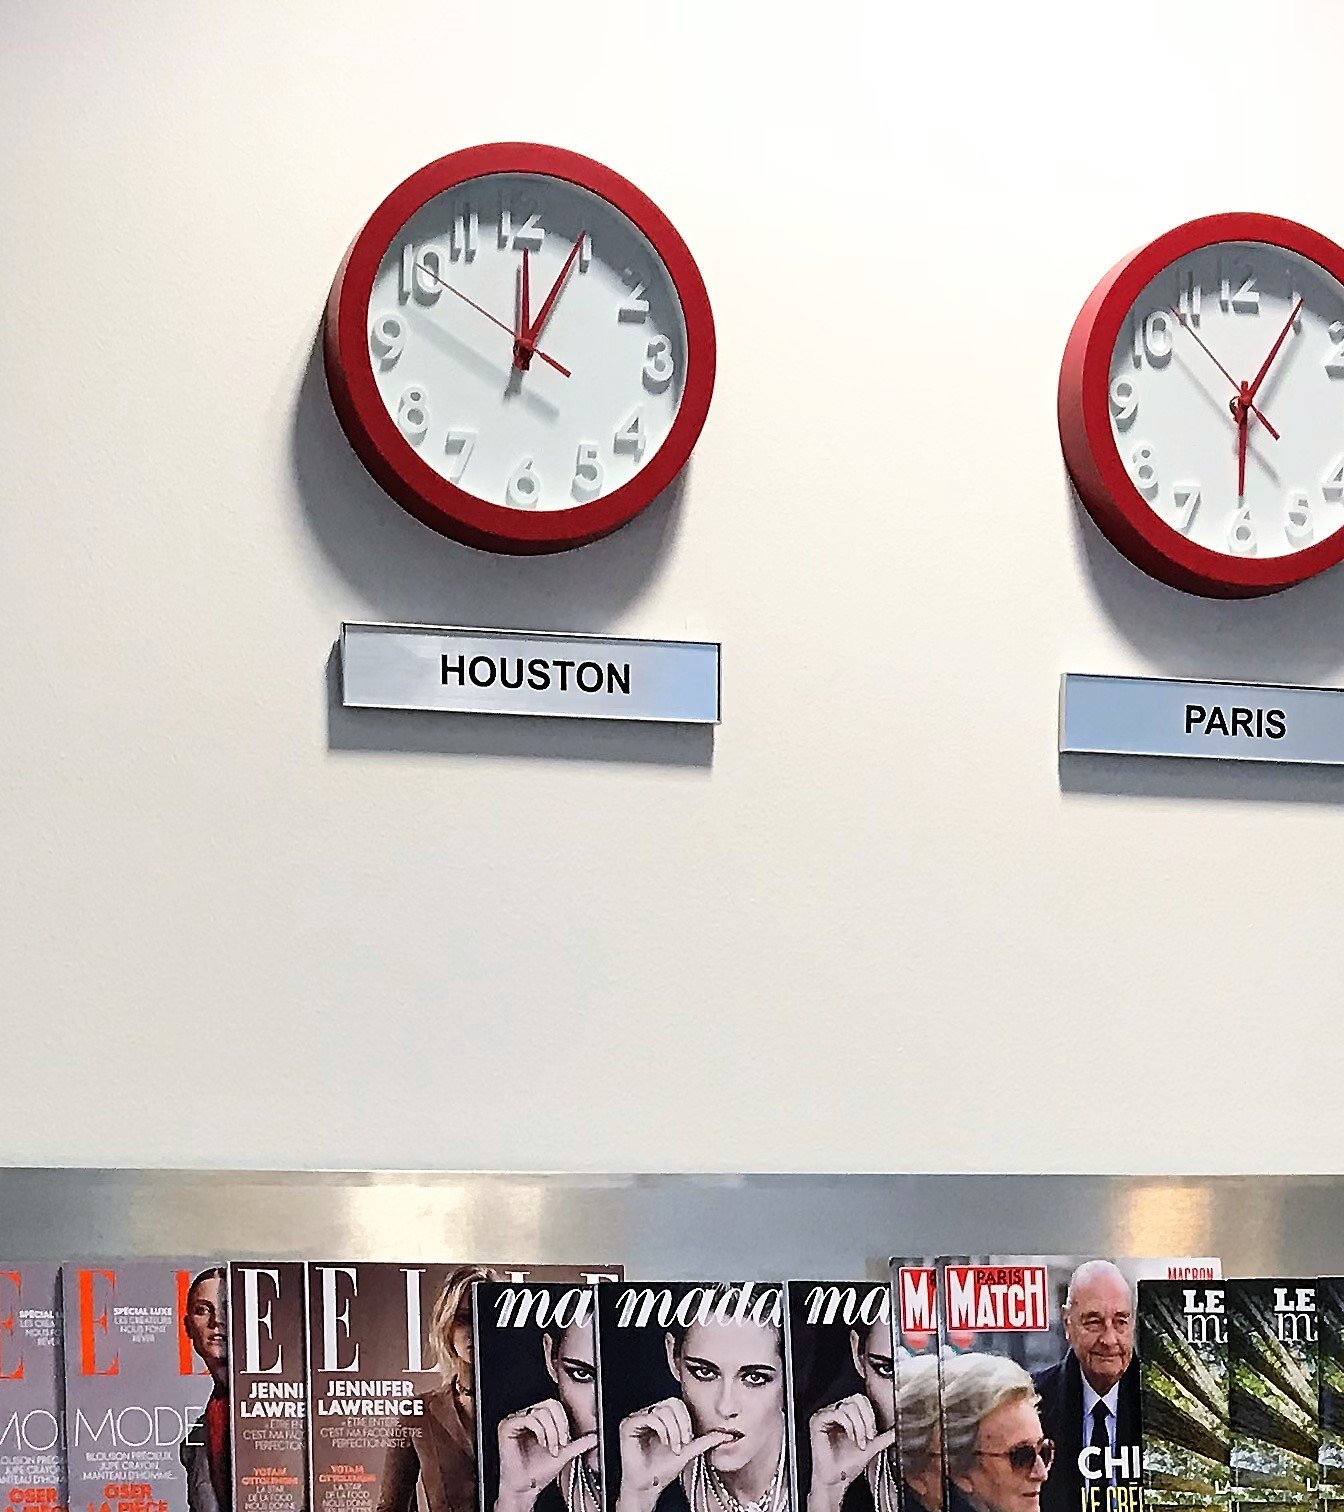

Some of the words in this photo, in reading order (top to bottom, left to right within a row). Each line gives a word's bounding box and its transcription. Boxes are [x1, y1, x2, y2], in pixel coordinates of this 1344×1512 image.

[439, 654, 632, 696] HOUSTON
[1183, 704, 1288, 741] PARIS
[976, 1270, 1022, 1285] PARIS
[951, 1270, 1046, 1329] MATCH
[1183, 1289, 1224, 1313] LE
[1274, 1288, 1315, 1311] LE
[326, 1380, 415, 1397] JENNIFER
[318, 1399, 424, 1416] LAWRENCE
[74, 1406, 205, 1448] MODE
